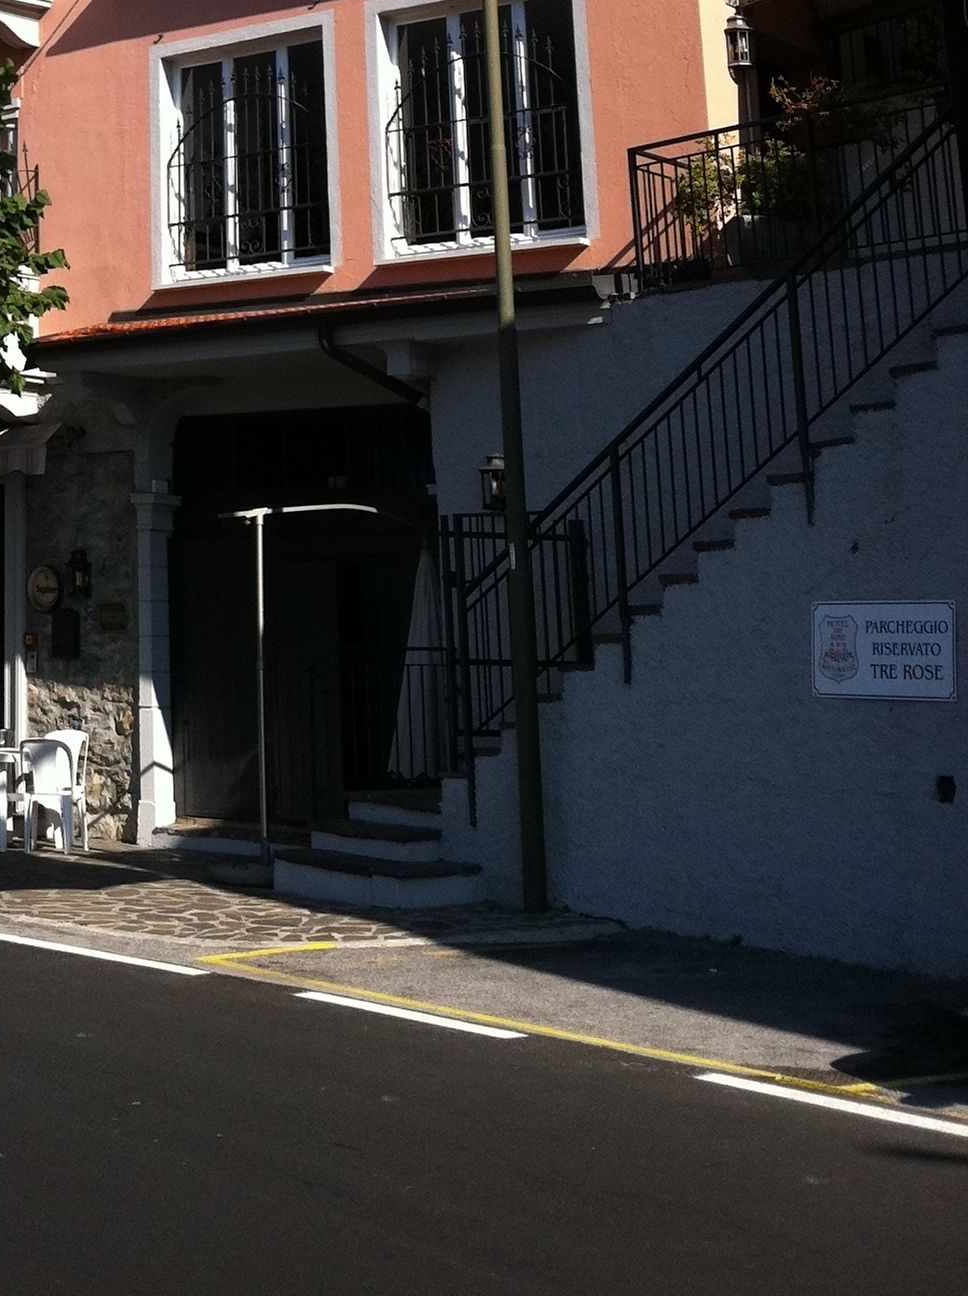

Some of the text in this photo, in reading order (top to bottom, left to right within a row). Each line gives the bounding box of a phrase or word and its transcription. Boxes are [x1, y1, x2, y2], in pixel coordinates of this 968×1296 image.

[865, 620, 949, 635] PARCHEGGIO
[872, 642, 942, 657] RISERVATO
[870, 663, 898, 680] TRE
[903, 664, 944, 681] ROSE
